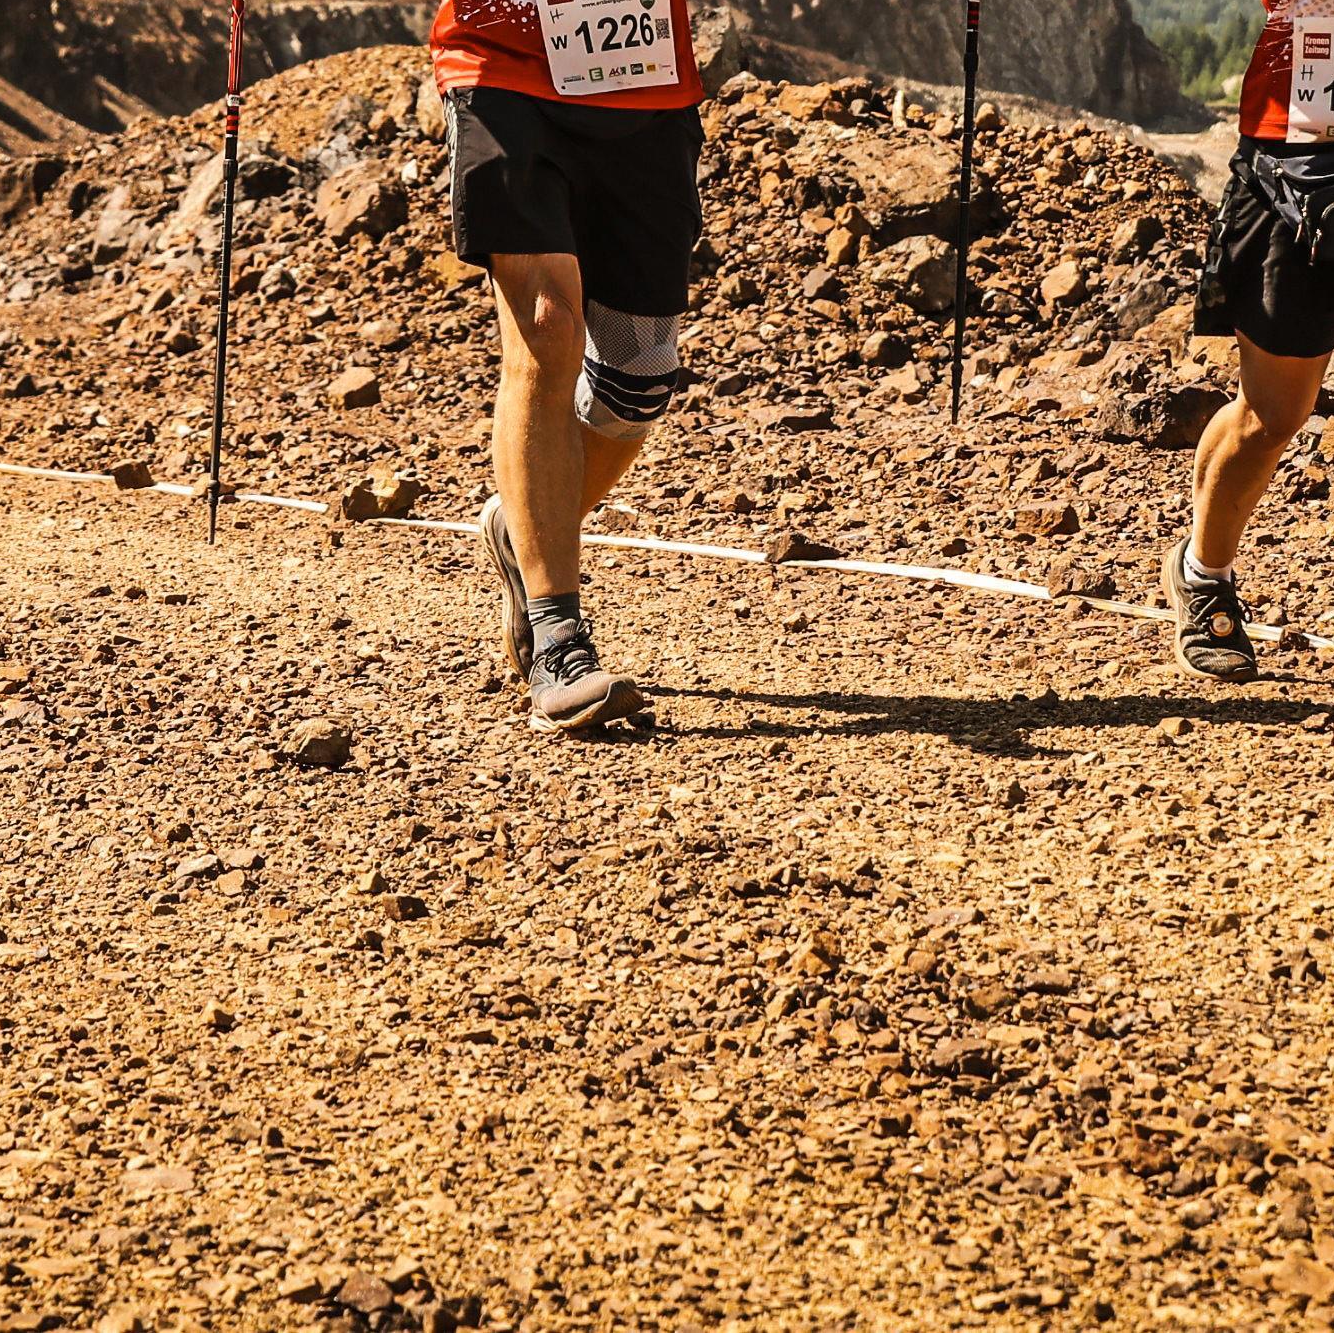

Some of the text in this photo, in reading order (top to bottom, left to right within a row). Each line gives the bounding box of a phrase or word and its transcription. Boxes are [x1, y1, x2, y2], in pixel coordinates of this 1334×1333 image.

[551, 12, 655, 54] W 1226
[1305, 36, 1330, 45] Kronen
[1305, 45, 1330, 55] Zeitung
[1297, 89, 1315, 102] W
